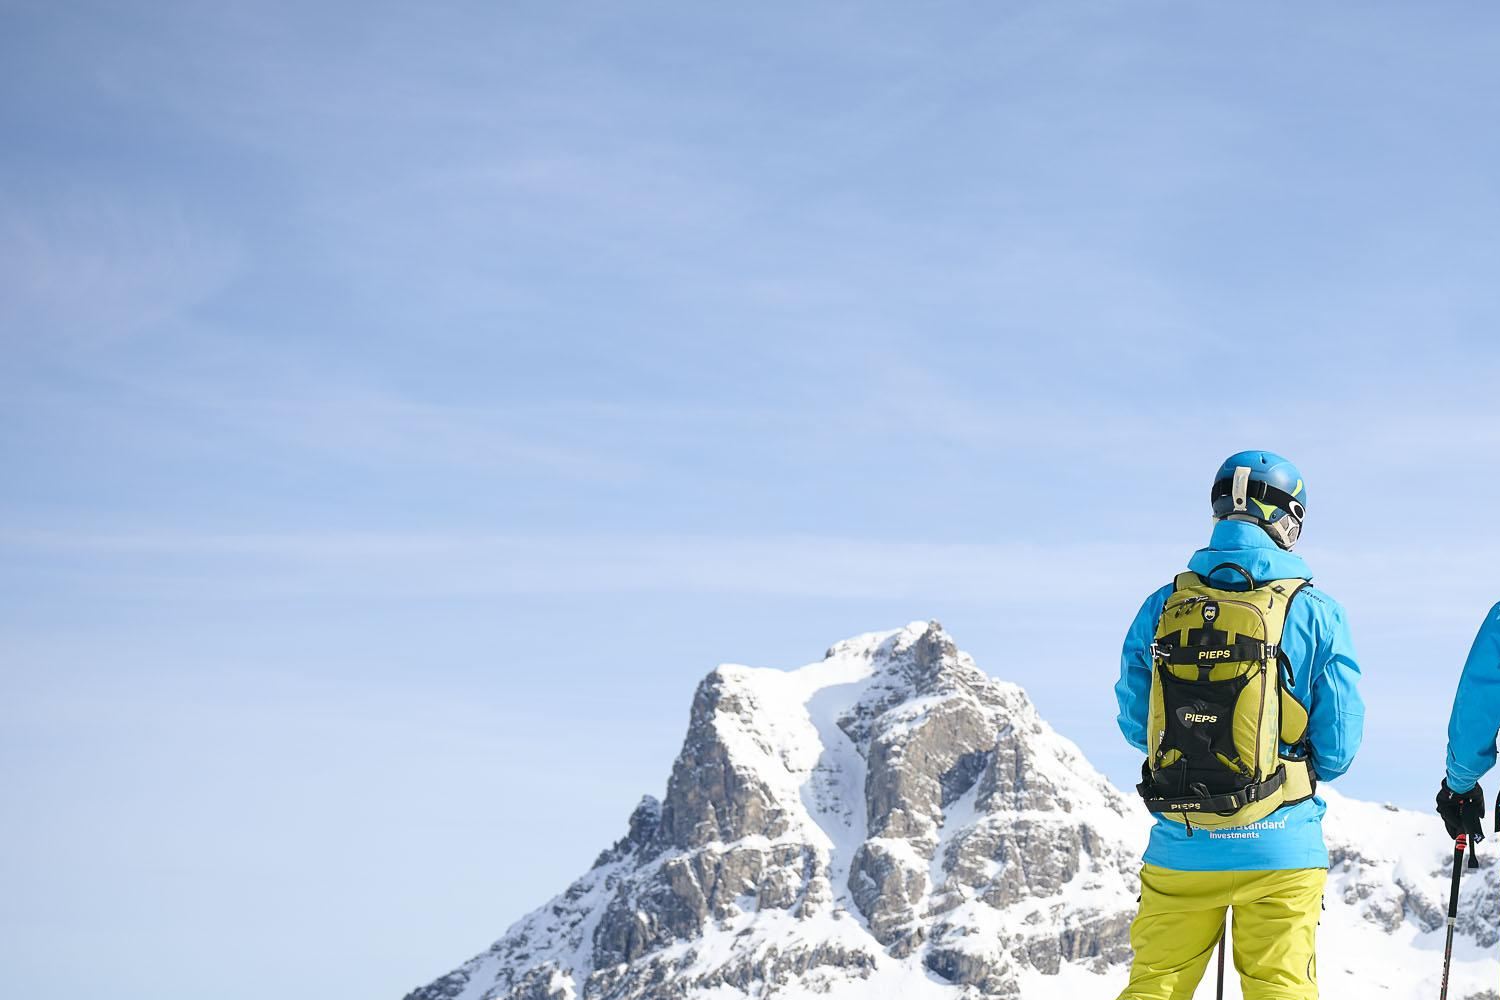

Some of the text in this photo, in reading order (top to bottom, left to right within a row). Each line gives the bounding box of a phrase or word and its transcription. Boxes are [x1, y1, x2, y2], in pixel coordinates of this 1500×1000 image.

[1198, 650, 1231, 660] PIEPS
[1184, 713, 1218, 723] PIEPS
[1171, 803, 1201, 811] PIEPS
